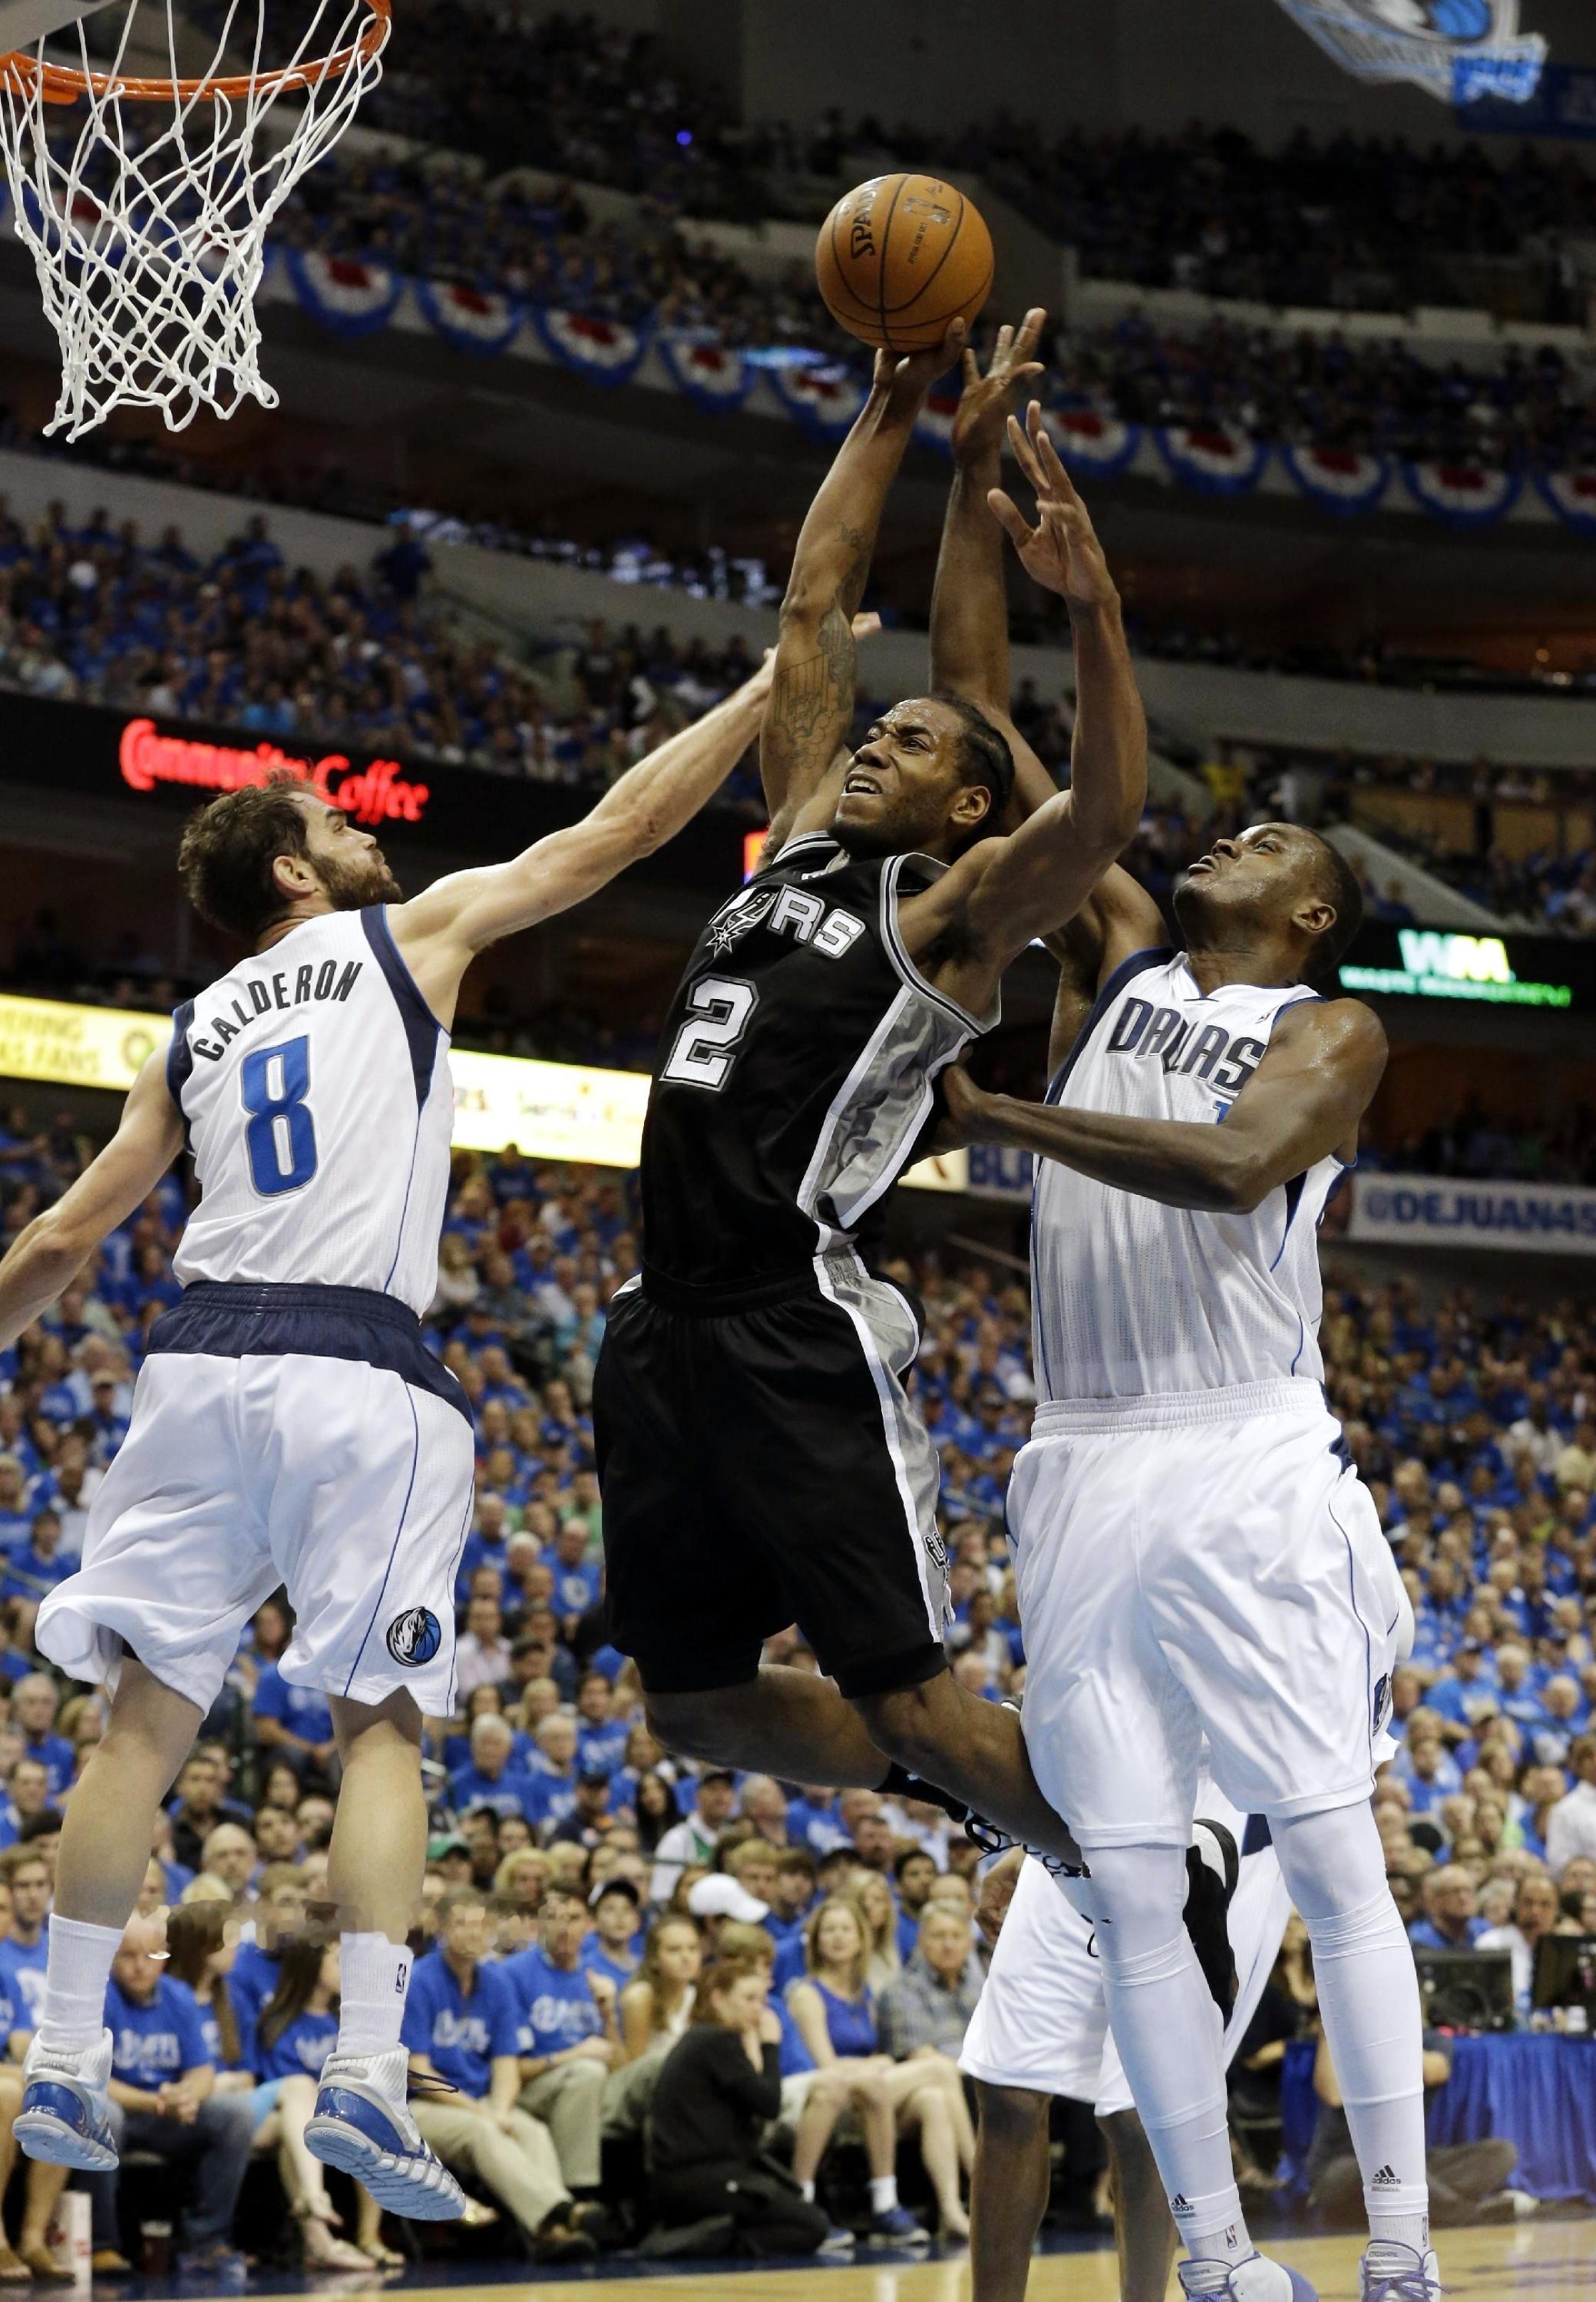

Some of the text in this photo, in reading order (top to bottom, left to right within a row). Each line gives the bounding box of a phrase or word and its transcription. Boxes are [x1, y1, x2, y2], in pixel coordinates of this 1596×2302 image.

[193, 959, 363, 1062] CALDERON
[659, 972, 760, 1092] 2
[240, 1033, 319, 1198] 8
